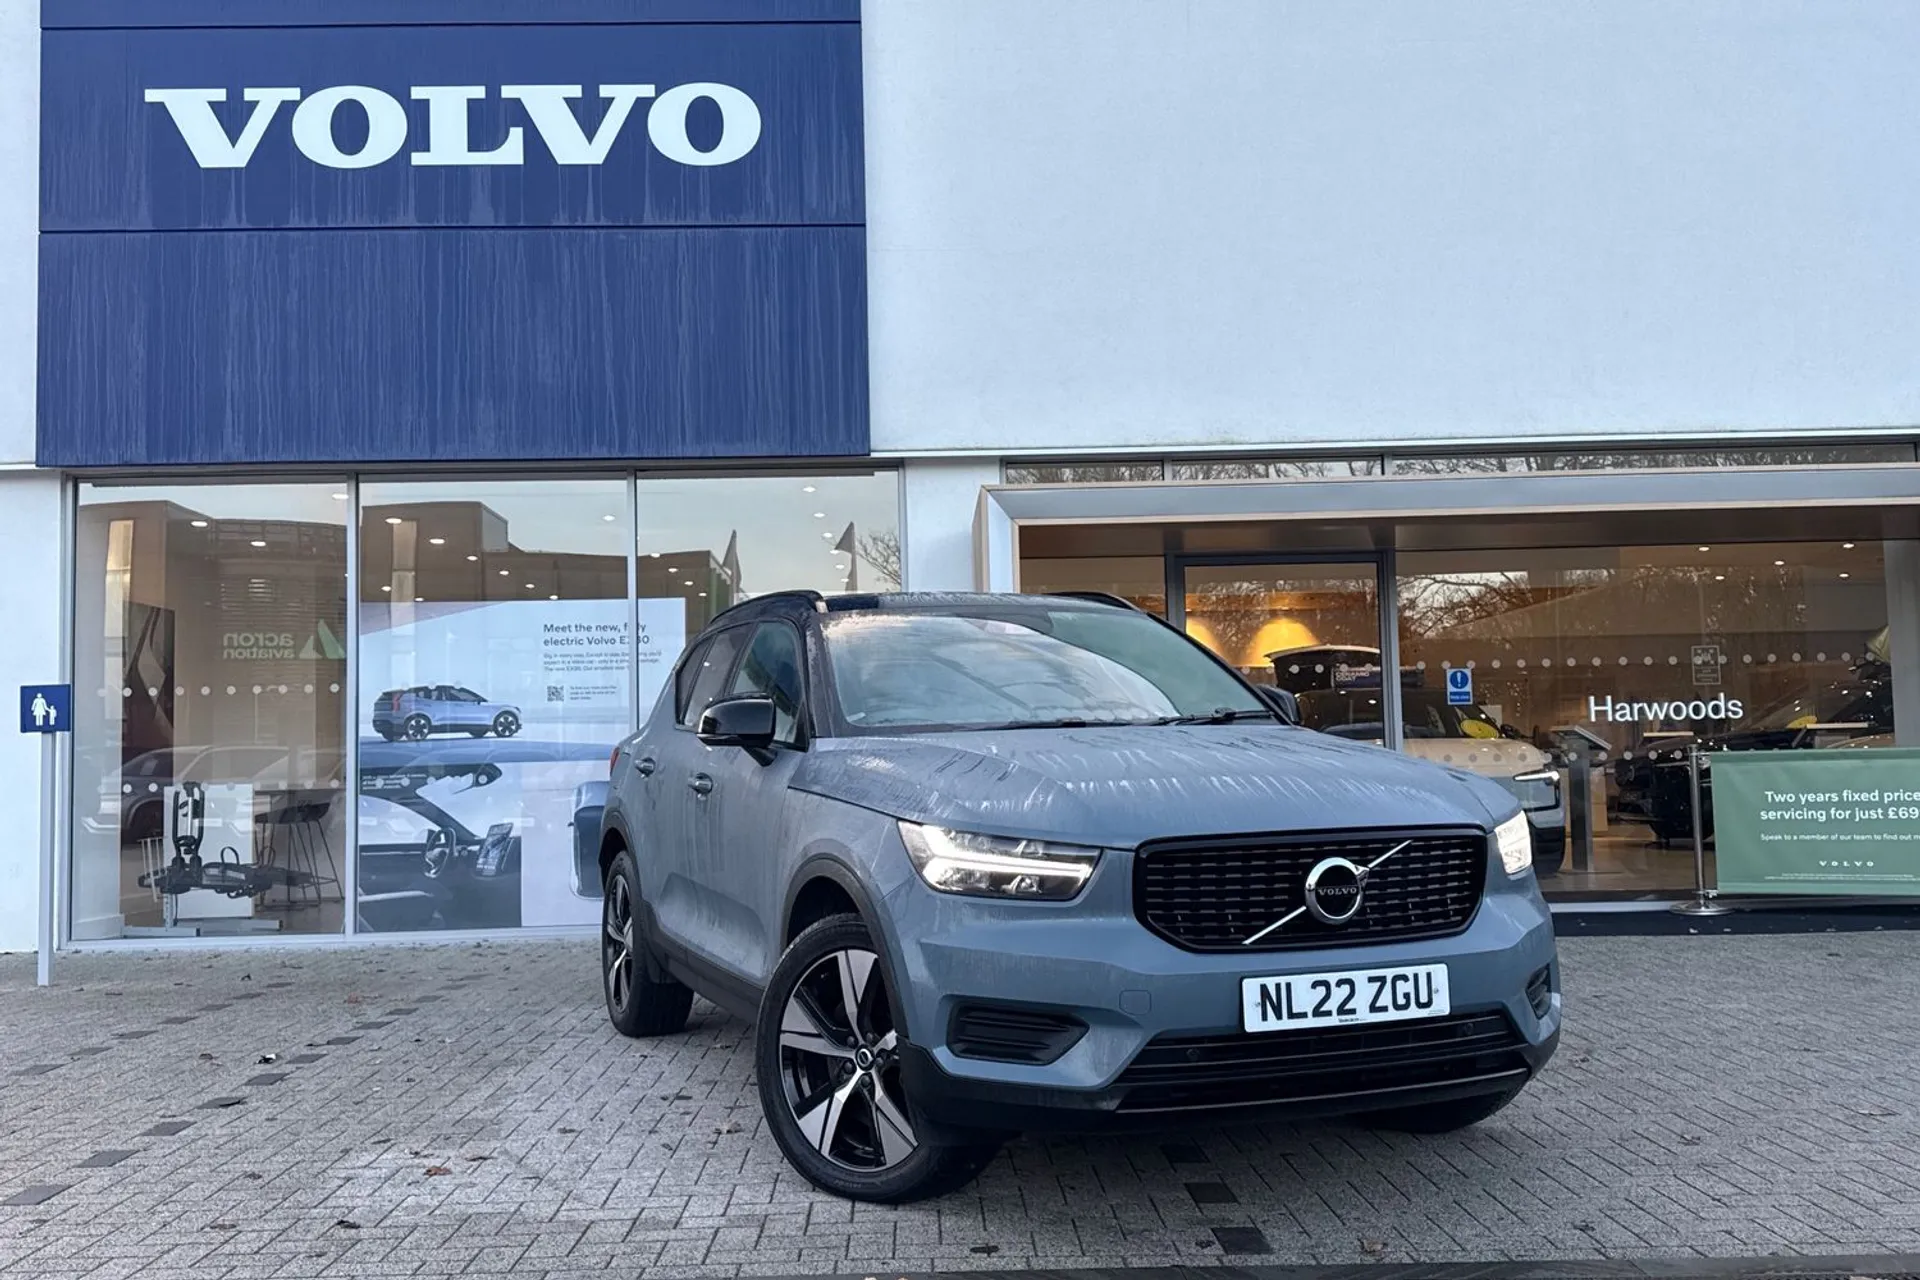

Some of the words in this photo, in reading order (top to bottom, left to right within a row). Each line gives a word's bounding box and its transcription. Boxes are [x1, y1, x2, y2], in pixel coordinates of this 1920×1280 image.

[144, 82, 762, 169] VOLVO
[543, 623, 572, 633] Meet
[574, 623, 593, 633] the
[595, 624, 621, 634] new,
[543, 636, 584, 646] electric
[586, 636, 616, 646] Volvo
[1588, 692, 1744, 722] Harwoods
[1764, 791, 1796, 803] Two
[1799, 791, 1839, 805] years
[1842, 789, 1879, 802] fixed
[1883, 788, 1920, 804] price
[1760, 808, 1827, 822] servicing
[1830, 807, 1851, 820] for
[1854, 807, 1884, 822] just
[1887, 806, 1920, 819] £69
[1761, 833, 1782, 843] Speak
[1799, 833, 1829, 841] member
[1830, 833, 1838, 841] of
[1853, 833, 1873, 841] team
[1873, 833, 1882, 841] to
[1883, 833, 1898, 841] find
[1899, 833, 1912, 841] out
[1317, 886, 1357, 896] VOLVO
[1259, 977, 1357, 1022] NL22
[1367, 971, 1434, 1014] ZGU
